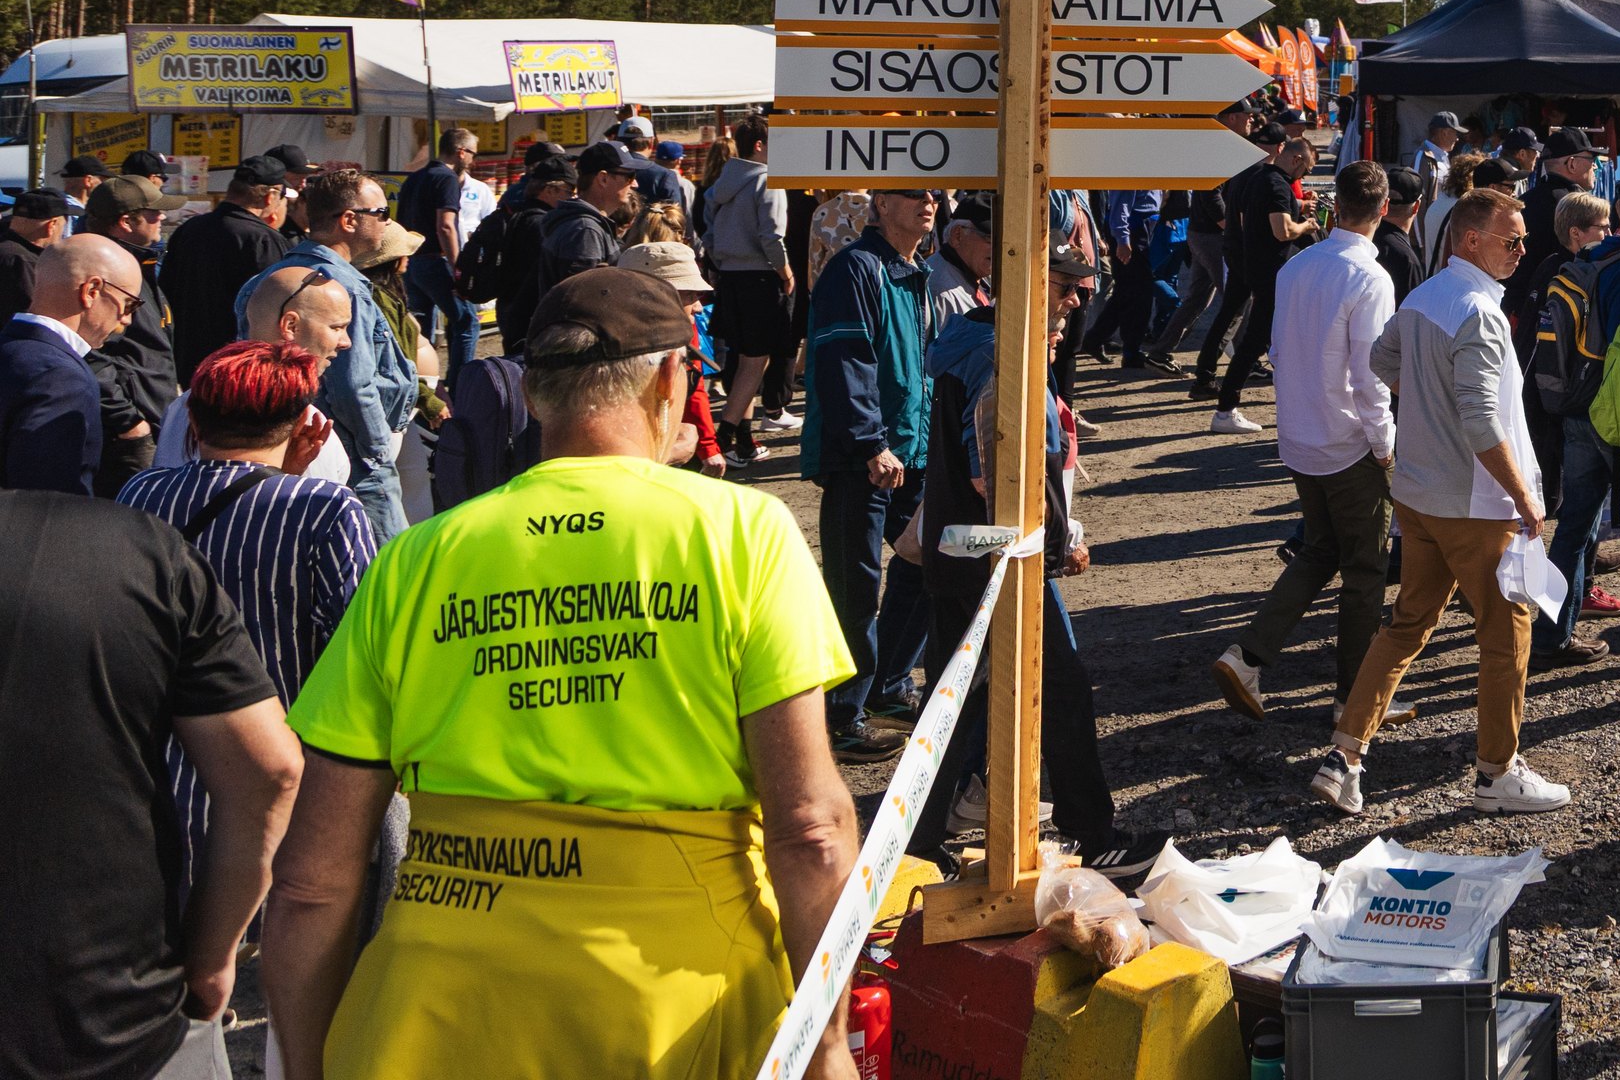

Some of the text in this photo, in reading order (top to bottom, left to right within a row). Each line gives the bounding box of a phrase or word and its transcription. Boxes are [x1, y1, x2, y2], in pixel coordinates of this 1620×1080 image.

[136, 34, 177, 66] SUURIN
[188, 35, 296, 49] SUOMALAINEN
[161, 55, 327, 81] METRILAKU
[518, 71, 616, 93] METRILAKUT
[831, 44, 1183, 95] SISÄOSTOT
[193, 87, 293, 104] VALIKOIMA
[825, 129, 950, 172] INFO
[527, 511, 606, 536] NYQS
[434, 581, 698, 644] JÄRJESTYKSENVALVOJA
[474, 631, 658, 677] ORDNINGSVAKT
[508, 672, 625, 710] SECURITY
[408, 829, 582, 877] TYKSENVALVOJA
[395, 874, 504, 912] SECURITY
[1369, 896, 1452, 916] KONTIO
[1363, 911, 1448, 930] MOTORS
